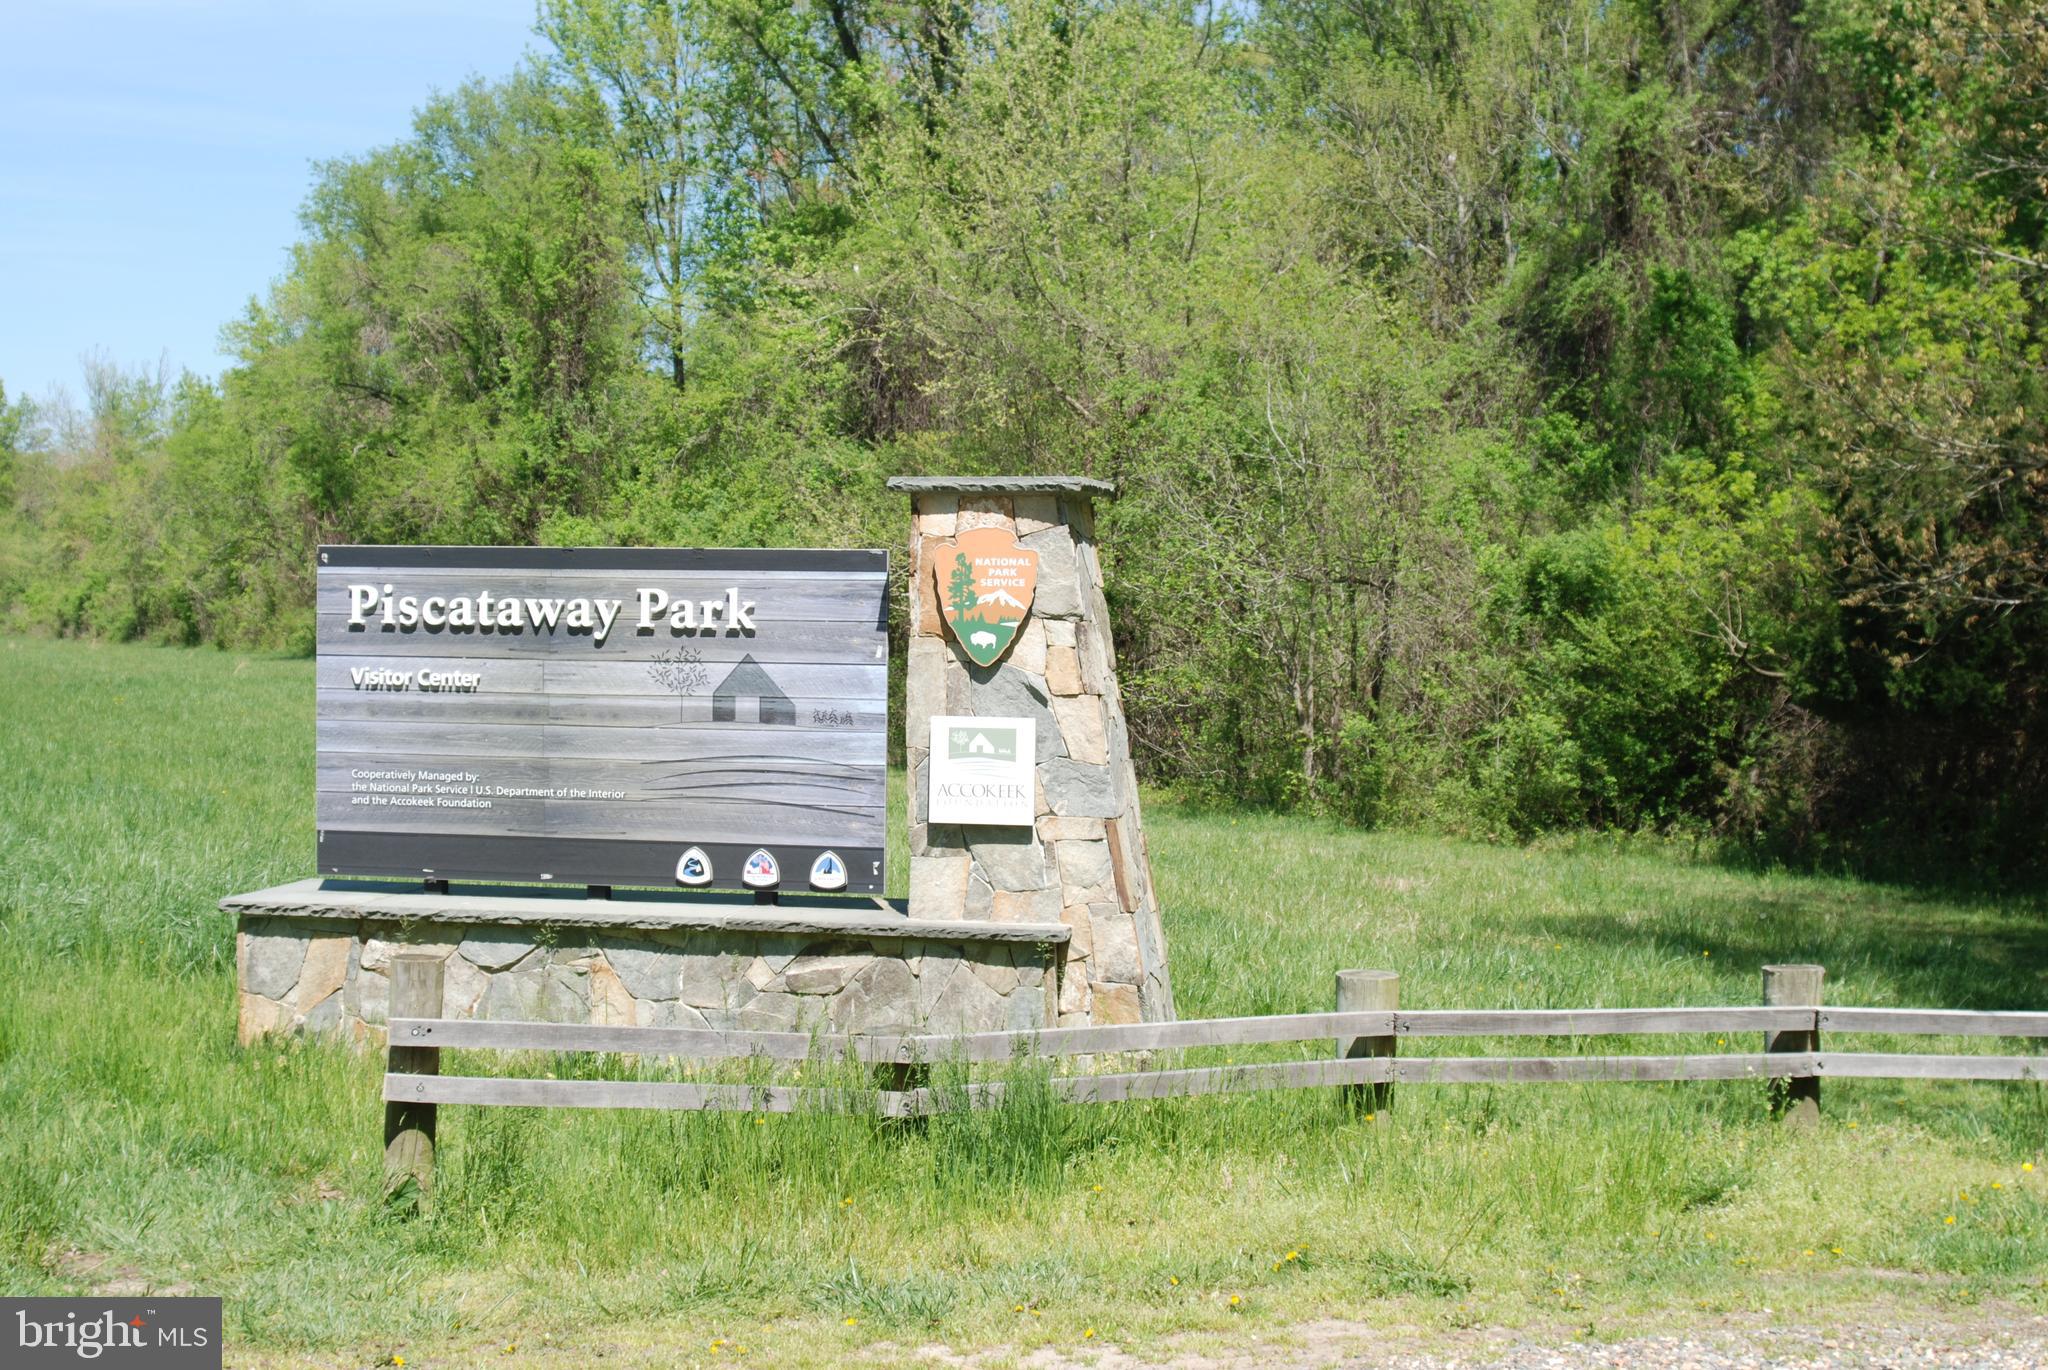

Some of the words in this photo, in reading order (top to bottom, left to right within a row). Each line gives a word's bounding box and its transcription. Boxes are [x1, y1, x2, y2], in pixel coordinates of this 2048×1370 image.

[975, 557, 1031, 566] NATIONAL
[988, 568, 1017, 577] PARK
[980, 578, 1026, 587] SERVICE
[347, 584, 622, 640] Piscataway
[636, 587, 757, 630] Park
[350, 667, 412, 686] Visitor
[417, 668, 481, 687] Center
[351, 769, 416, 781] Cooperatively
[418, 770, 463, 783] Managed
[465, 772, 480, 783] by:
[351, 782, 367, 791] the
[369, 782, 409, 793] National
[412, 783, 433, 793] Park
[435, 784, 468, 794] Service
[475, 785, 494, 795] U.S.
[496, 786, 554, 797] Department
[556, 788, 567, 797] of
[570, 788, 586, 798] the
[589, 789, 625, 799] Interior
[351, 796, 369, 805] and
[372, 796, 387, 805] the
[390, 796, 434, 806] Accokeek
[437, 797, 492, 808] Foundation
